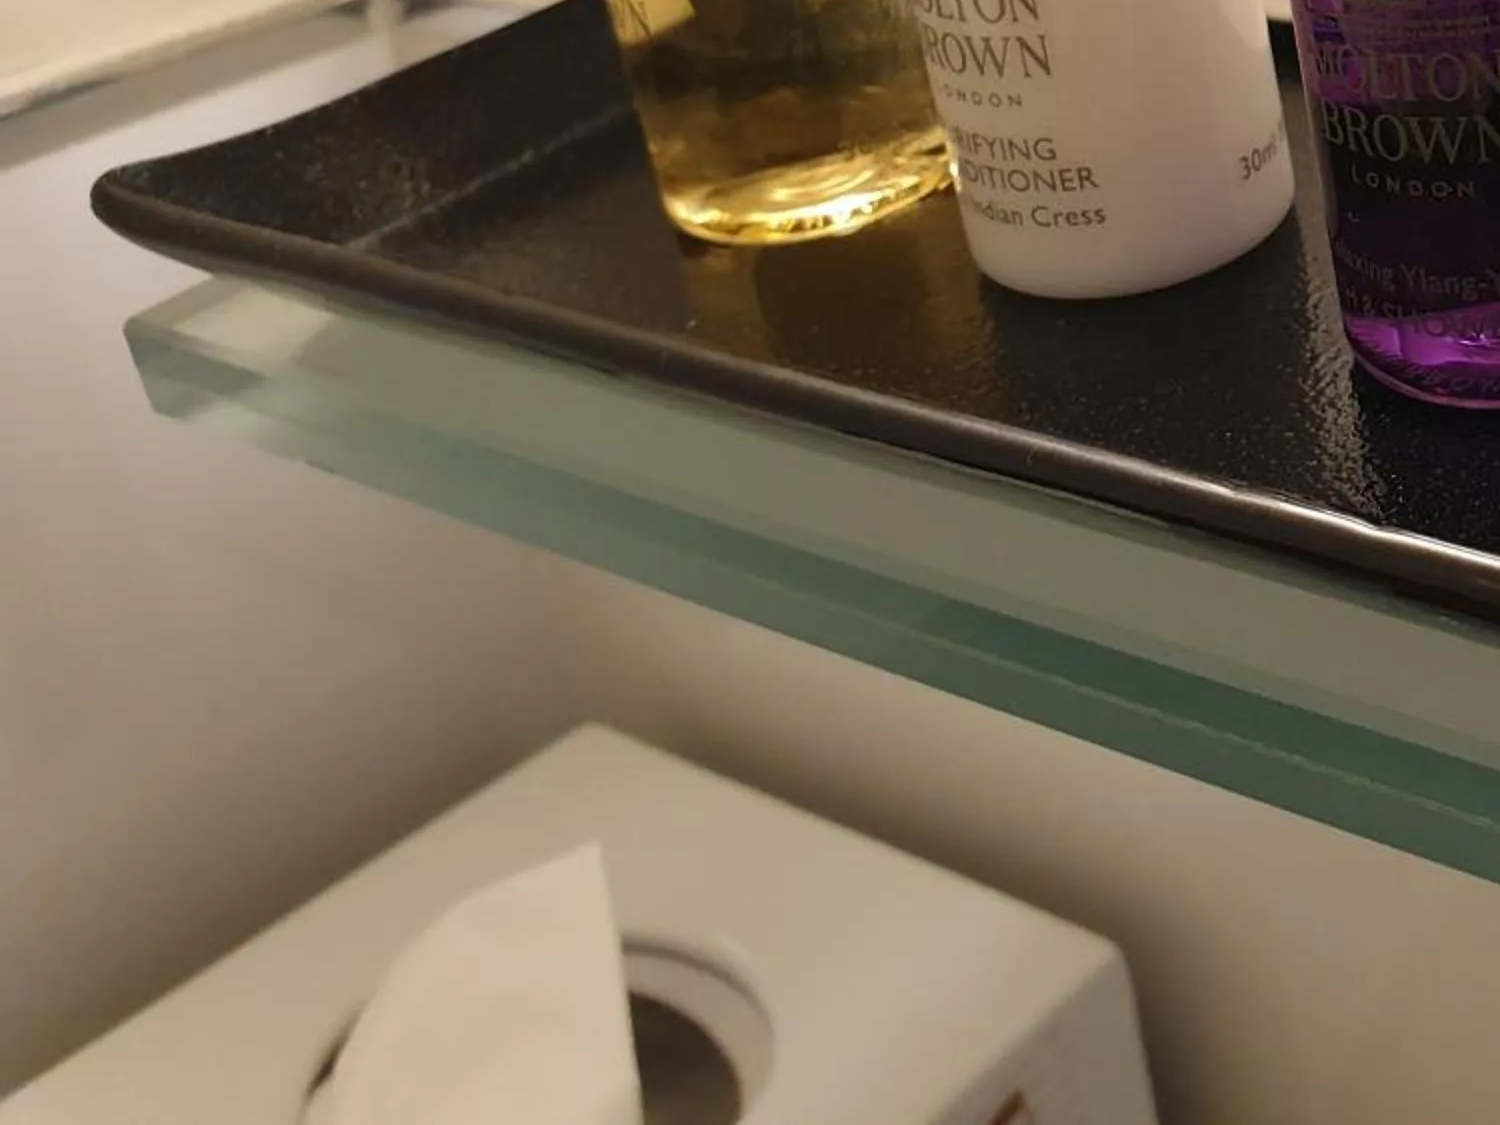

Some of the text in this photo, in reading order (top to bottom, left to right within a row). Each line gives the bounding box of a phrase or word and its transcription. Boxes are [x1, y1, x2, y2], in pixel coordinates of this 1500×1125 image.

[918, 23, 1051, 79] ROWN
[1351, 166, 1476, 198] LONDON
[1031, 204, 1107, 227] Cress
